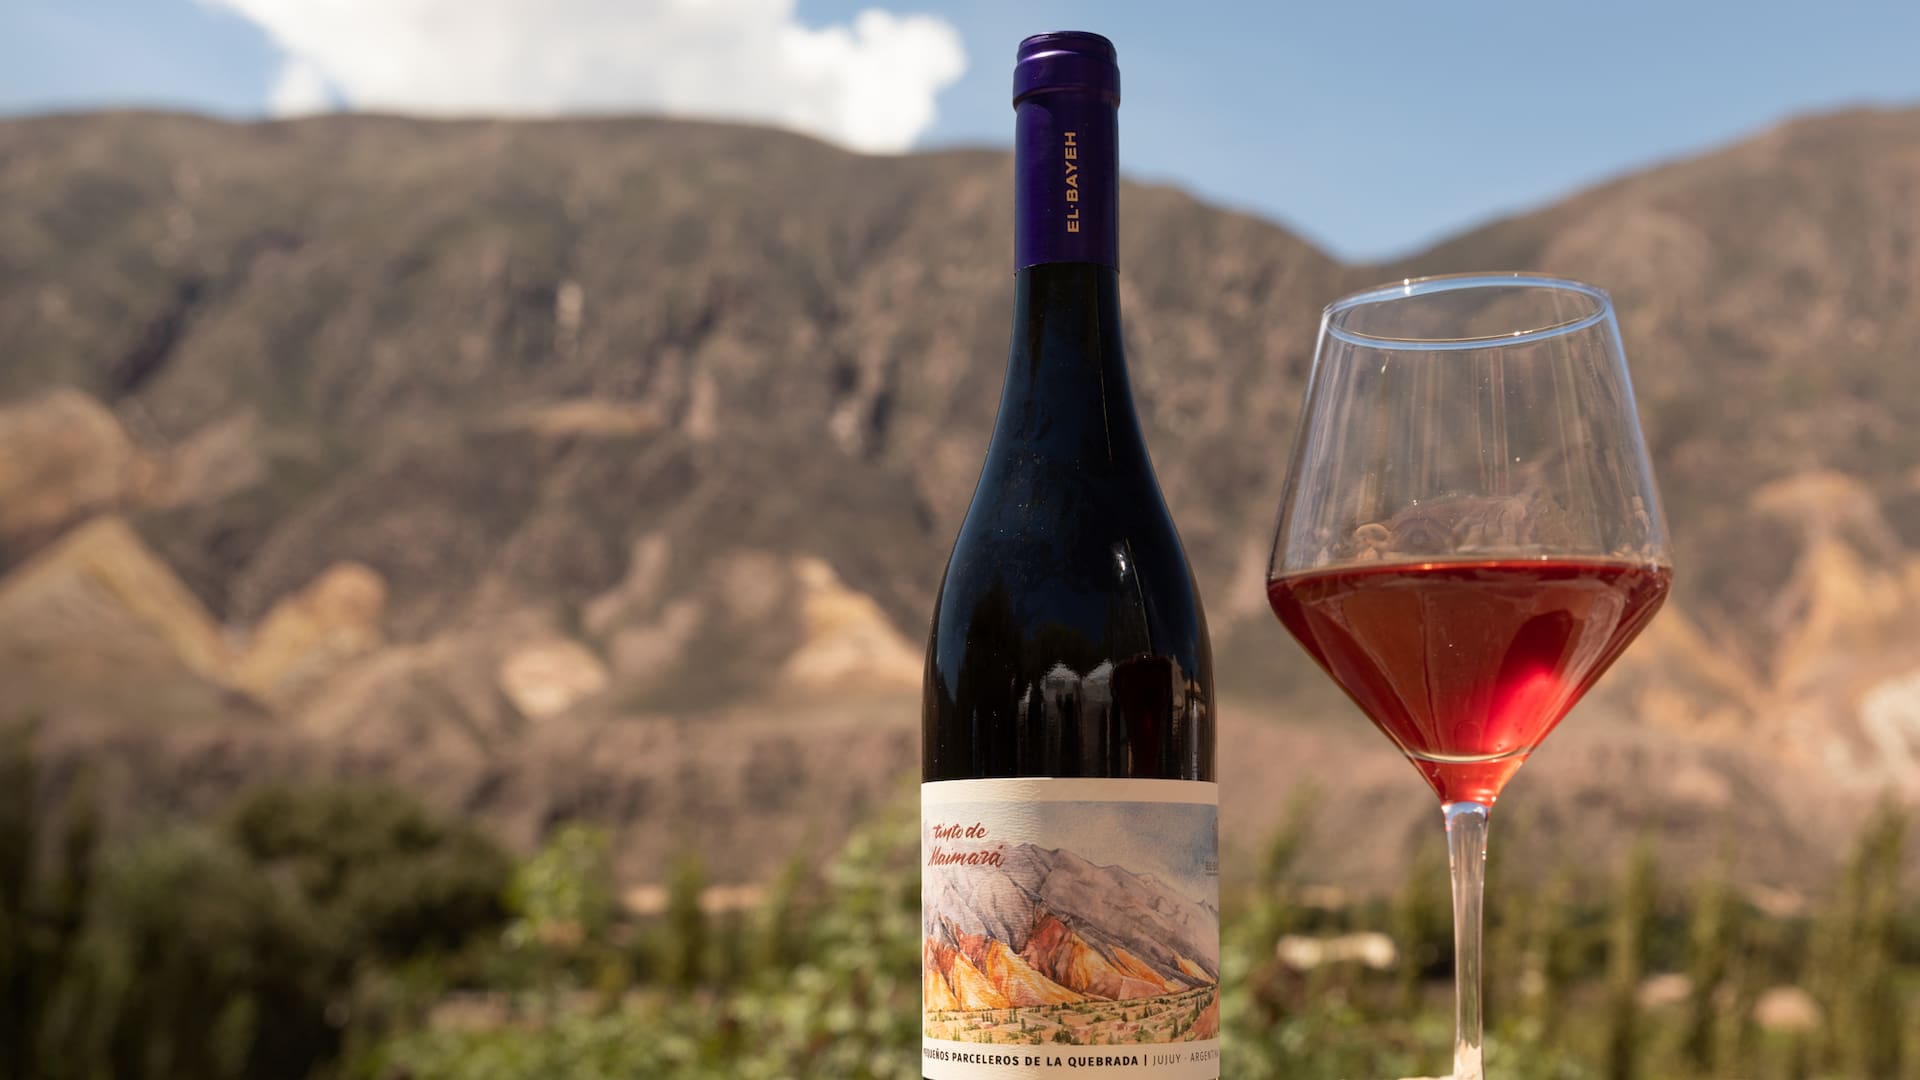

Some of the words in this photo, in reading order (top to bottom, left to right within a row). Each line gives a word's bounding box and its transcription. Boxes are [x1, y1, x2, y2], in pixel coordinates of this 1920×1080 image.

[933, 823, 964, 842] tinto
[965, 822, 989, 839] de
[928, 845, 1006, 868] Maimará
[952, 1052, 1019, 1066] PARCELEROS
[1025, 1056, 1041, 1067] DE
[1046, 1056, 1062, 1067] LA
[1068, 1056, 1139, 1068] QUEBRADA
[1153, 1054, 1181, 1066] JUJUY
